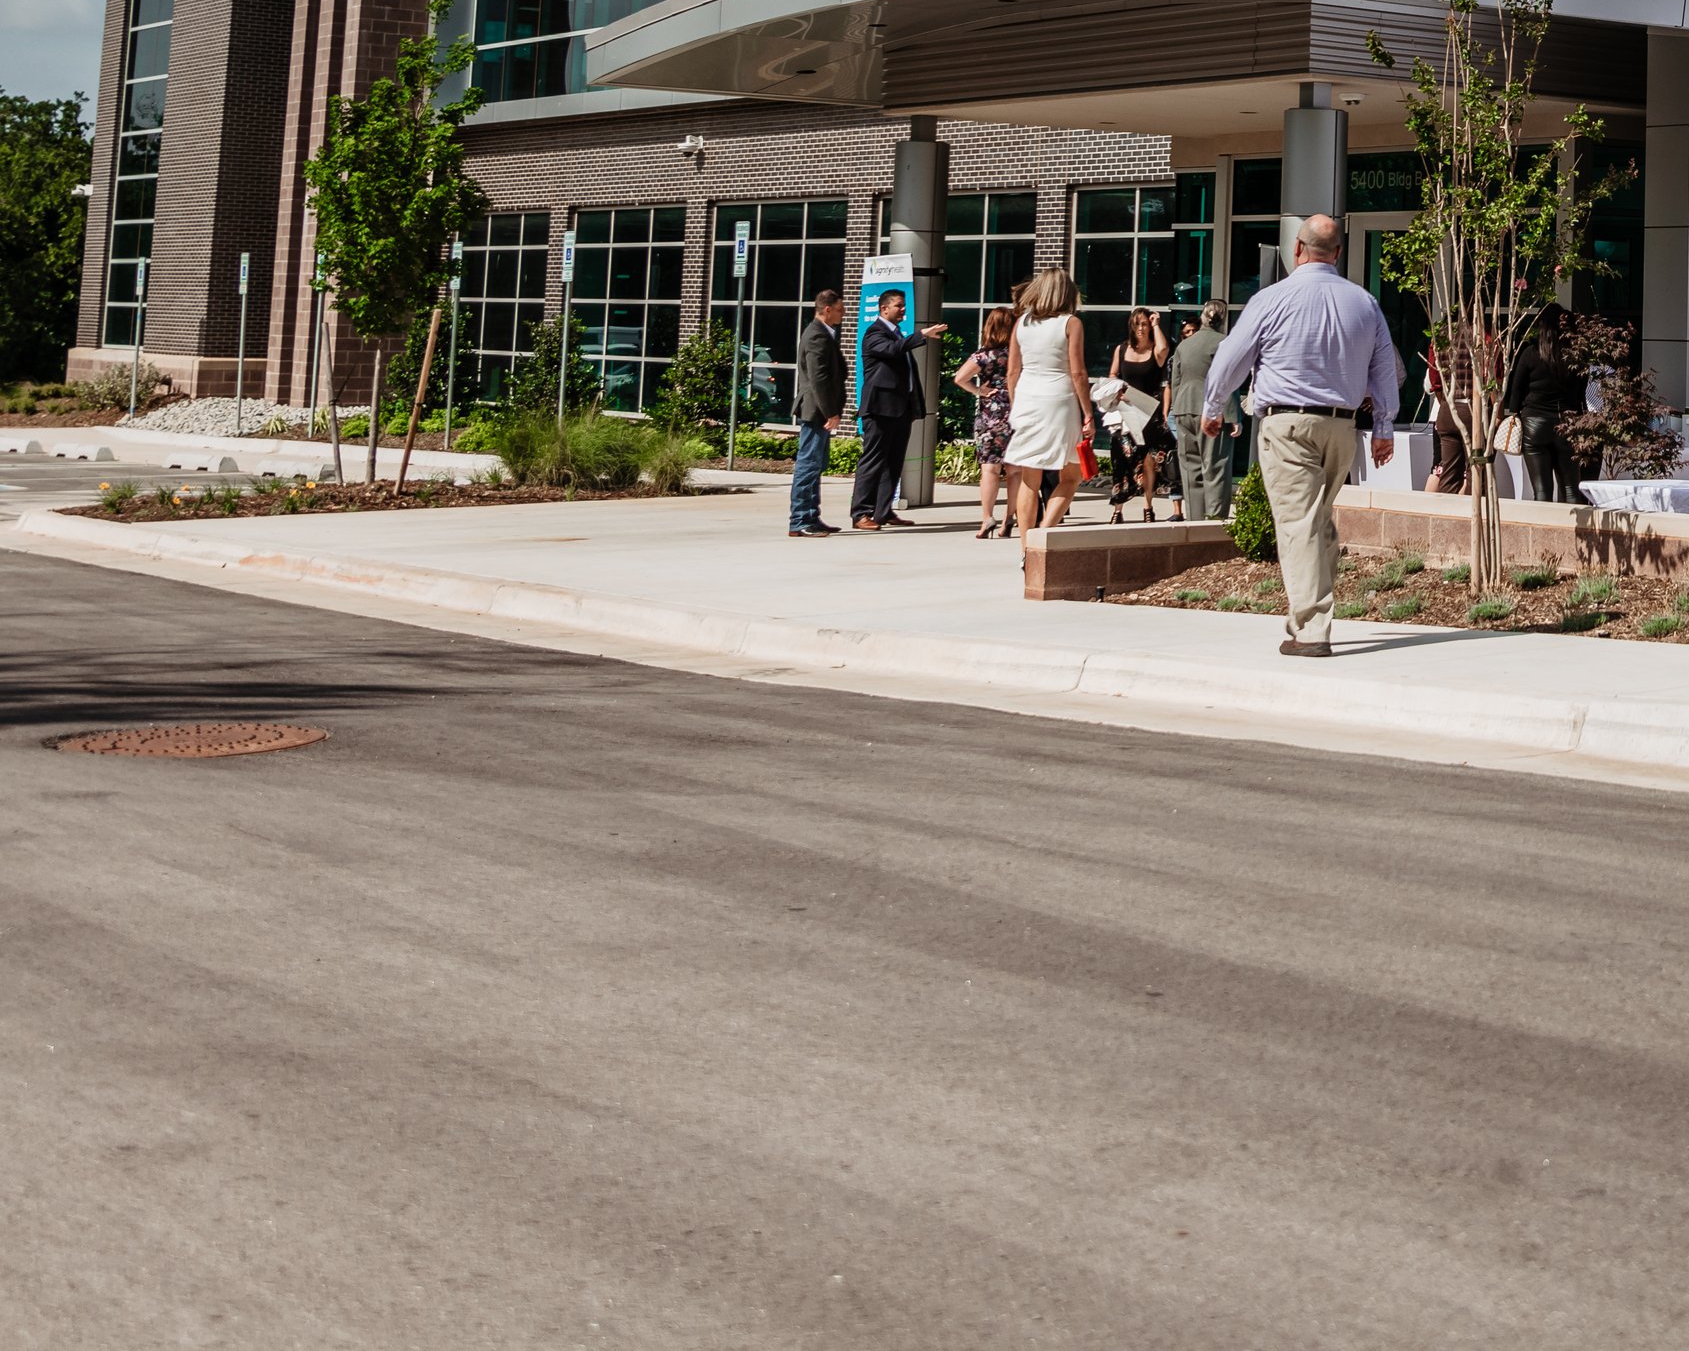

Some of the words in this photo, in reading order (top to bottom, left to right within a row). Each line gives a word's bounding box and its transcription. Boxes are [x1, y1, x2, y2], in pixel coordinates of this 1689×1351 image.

[1350, 170, 1384, 189] 5400
[1388, 172, 1412, 189] Bldg
[1415, 171, 1423, 186] B
